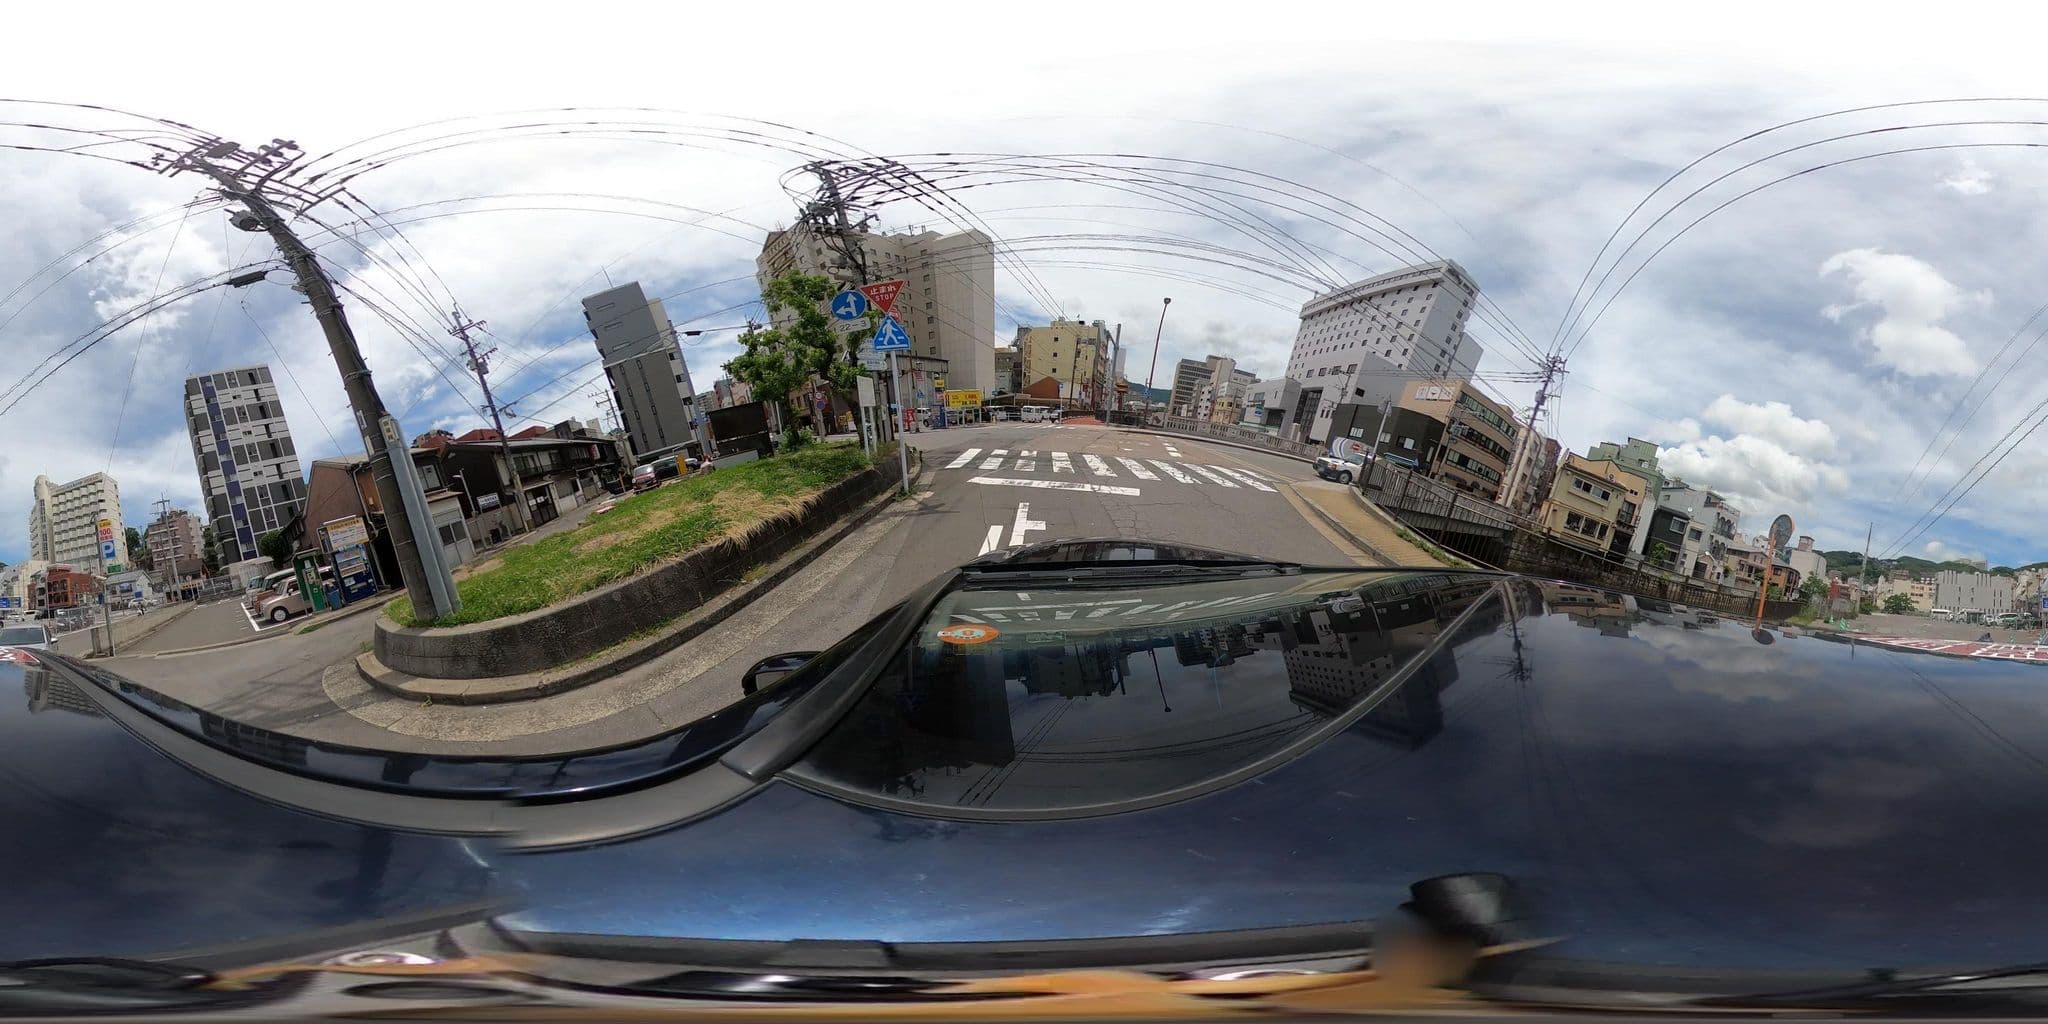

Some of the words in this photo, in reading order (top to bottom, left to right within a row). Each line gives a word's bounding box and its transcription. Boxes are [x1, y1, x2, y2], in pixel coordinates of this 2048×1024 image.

[870, 284, 897, 295] 止まれ
[875, 293, 895, 302] STOP
[101, 542, 114, 559] P
